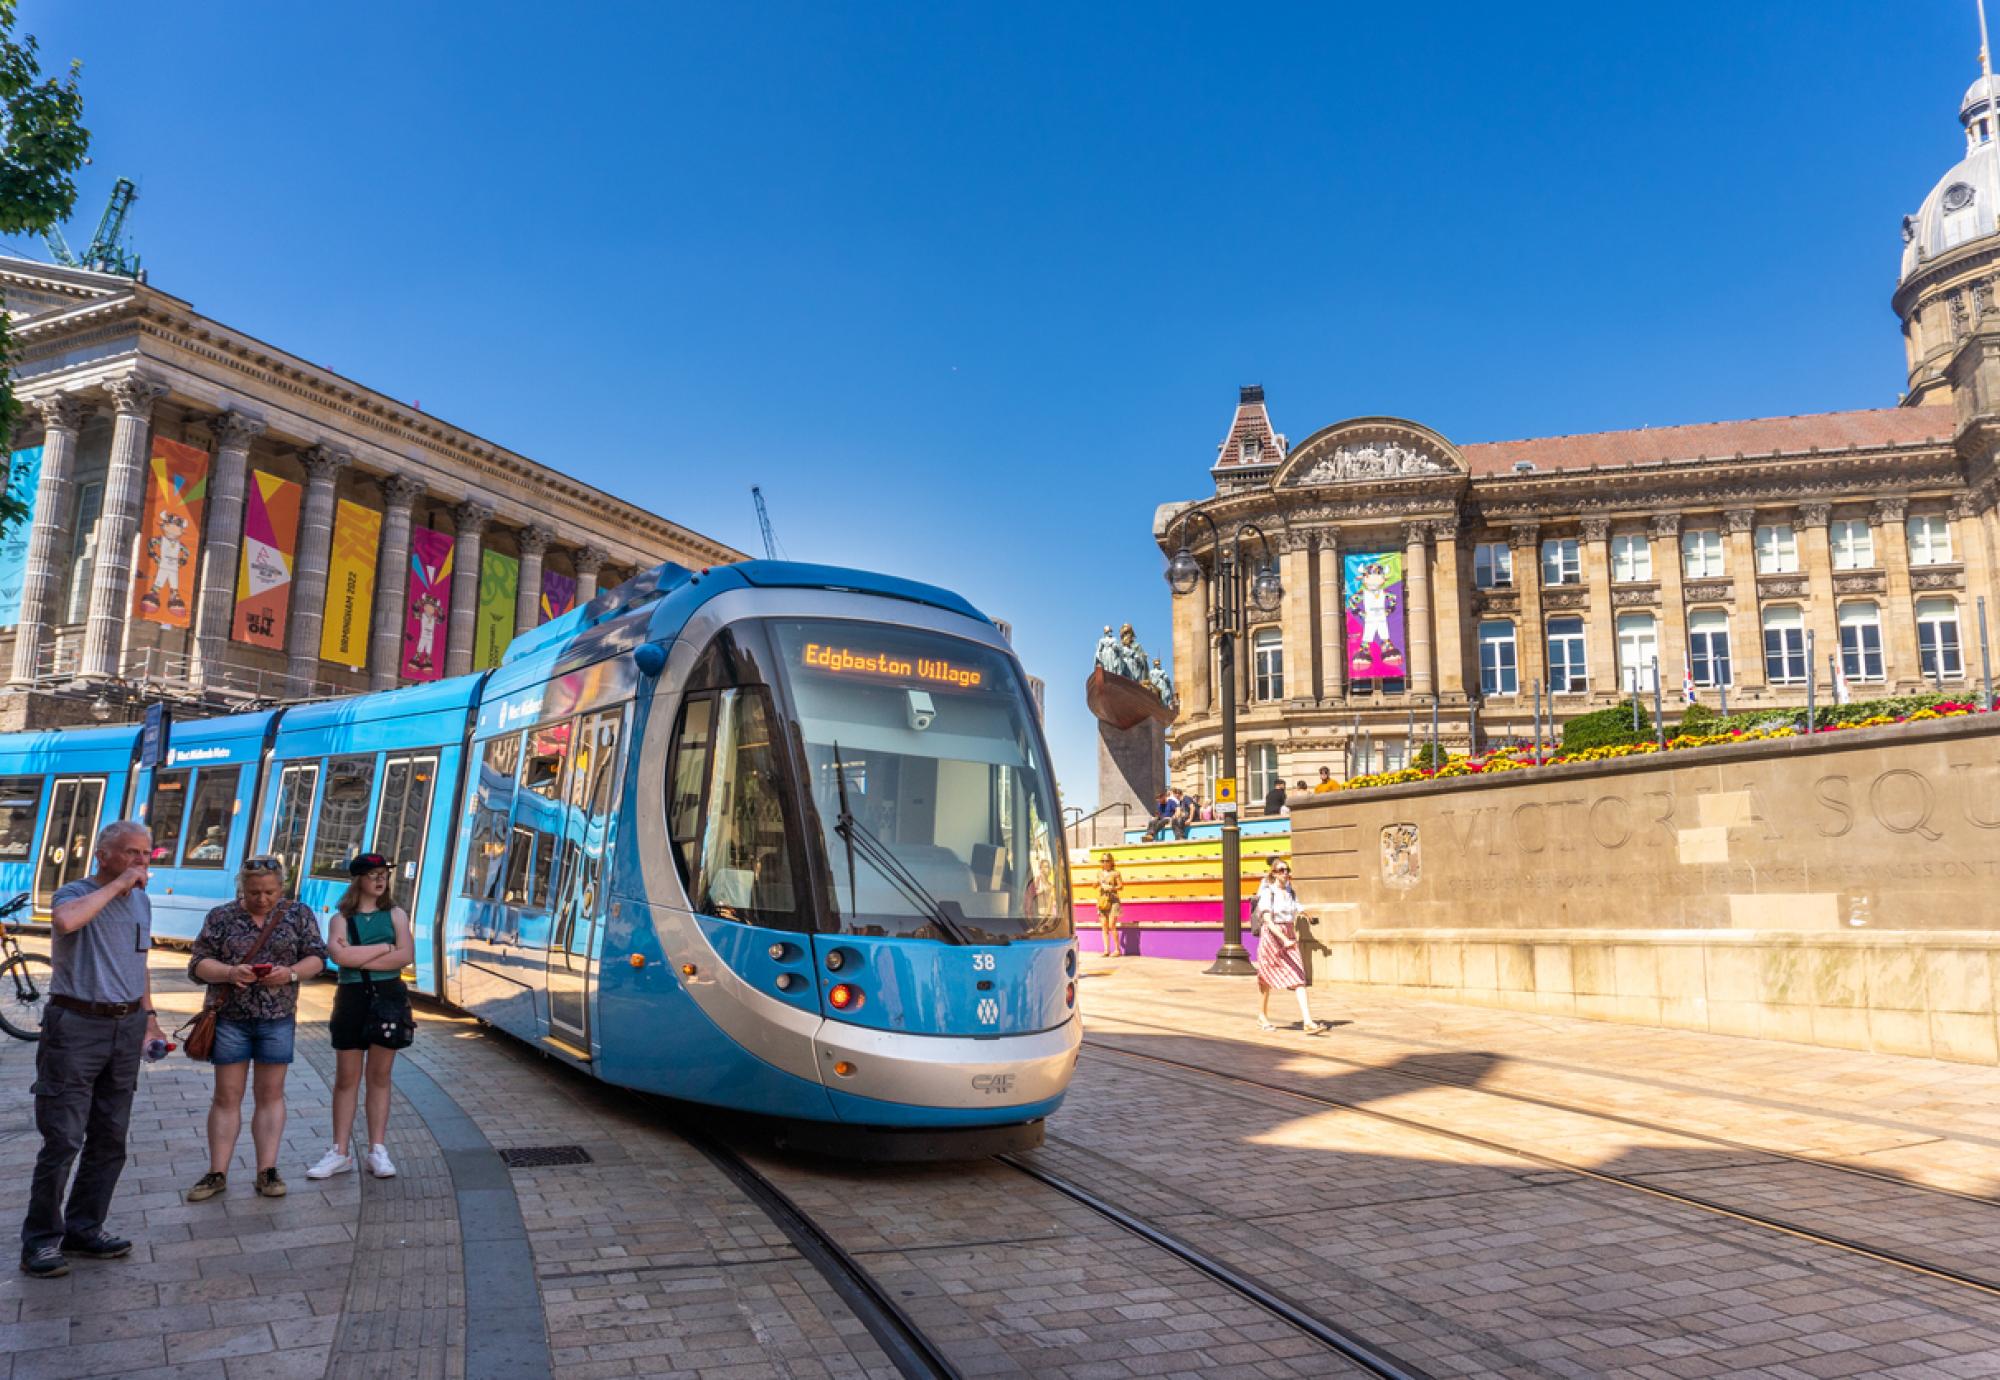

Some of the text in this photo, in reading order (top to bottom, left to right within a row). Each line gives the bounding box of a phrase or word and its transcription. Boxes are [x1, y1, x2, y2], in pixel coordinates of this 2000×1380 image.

[805, 643, 981, 687] Edgbaston Village
[1441, 783, 1785, 856] VICTORA
[972, 953, 996, 971] 38
[971, 1073, 1016, 1095] CAF
